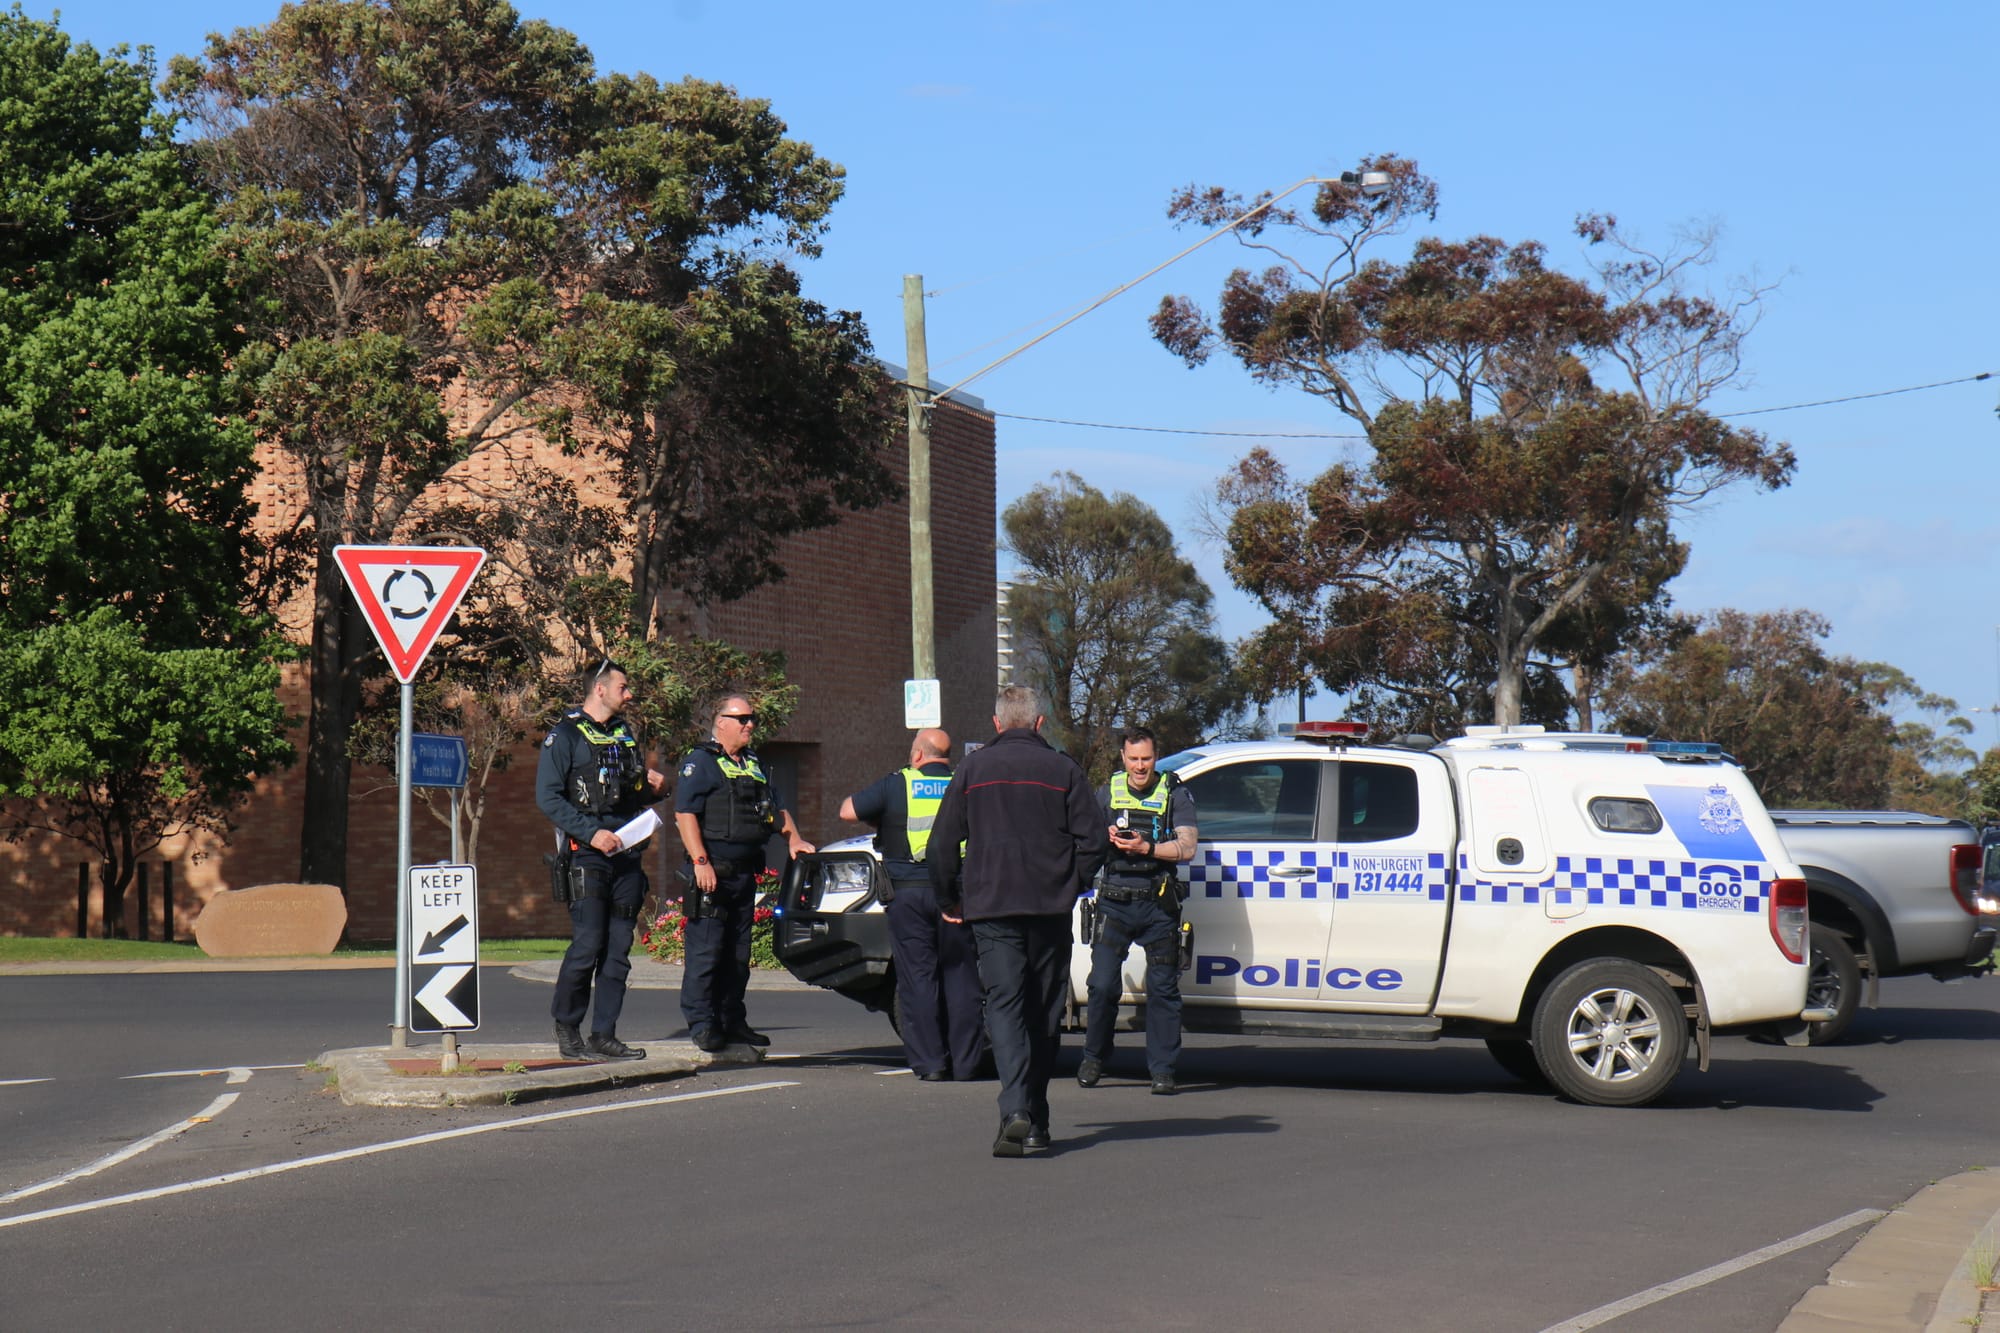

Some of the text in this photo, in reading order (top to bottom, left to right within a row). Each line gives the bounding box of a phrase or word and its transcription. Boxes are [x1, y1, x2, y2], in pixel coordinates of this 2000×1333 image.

[439, 745, 455, 759] Island
[914, 781, 948, 795] Poli
[1353, 858, 1423, 871] NON-URGENT
[421, 874, 463, 889] KEEP
[1354, 873, 1423, 892] 131 444
[1699, 881, 1742, 897] 000
[423, 892, 462, 907] LEFT
[1699, 897, 1742, 909] EMERGENCY
[1196, 955, 1403, 990] Police
